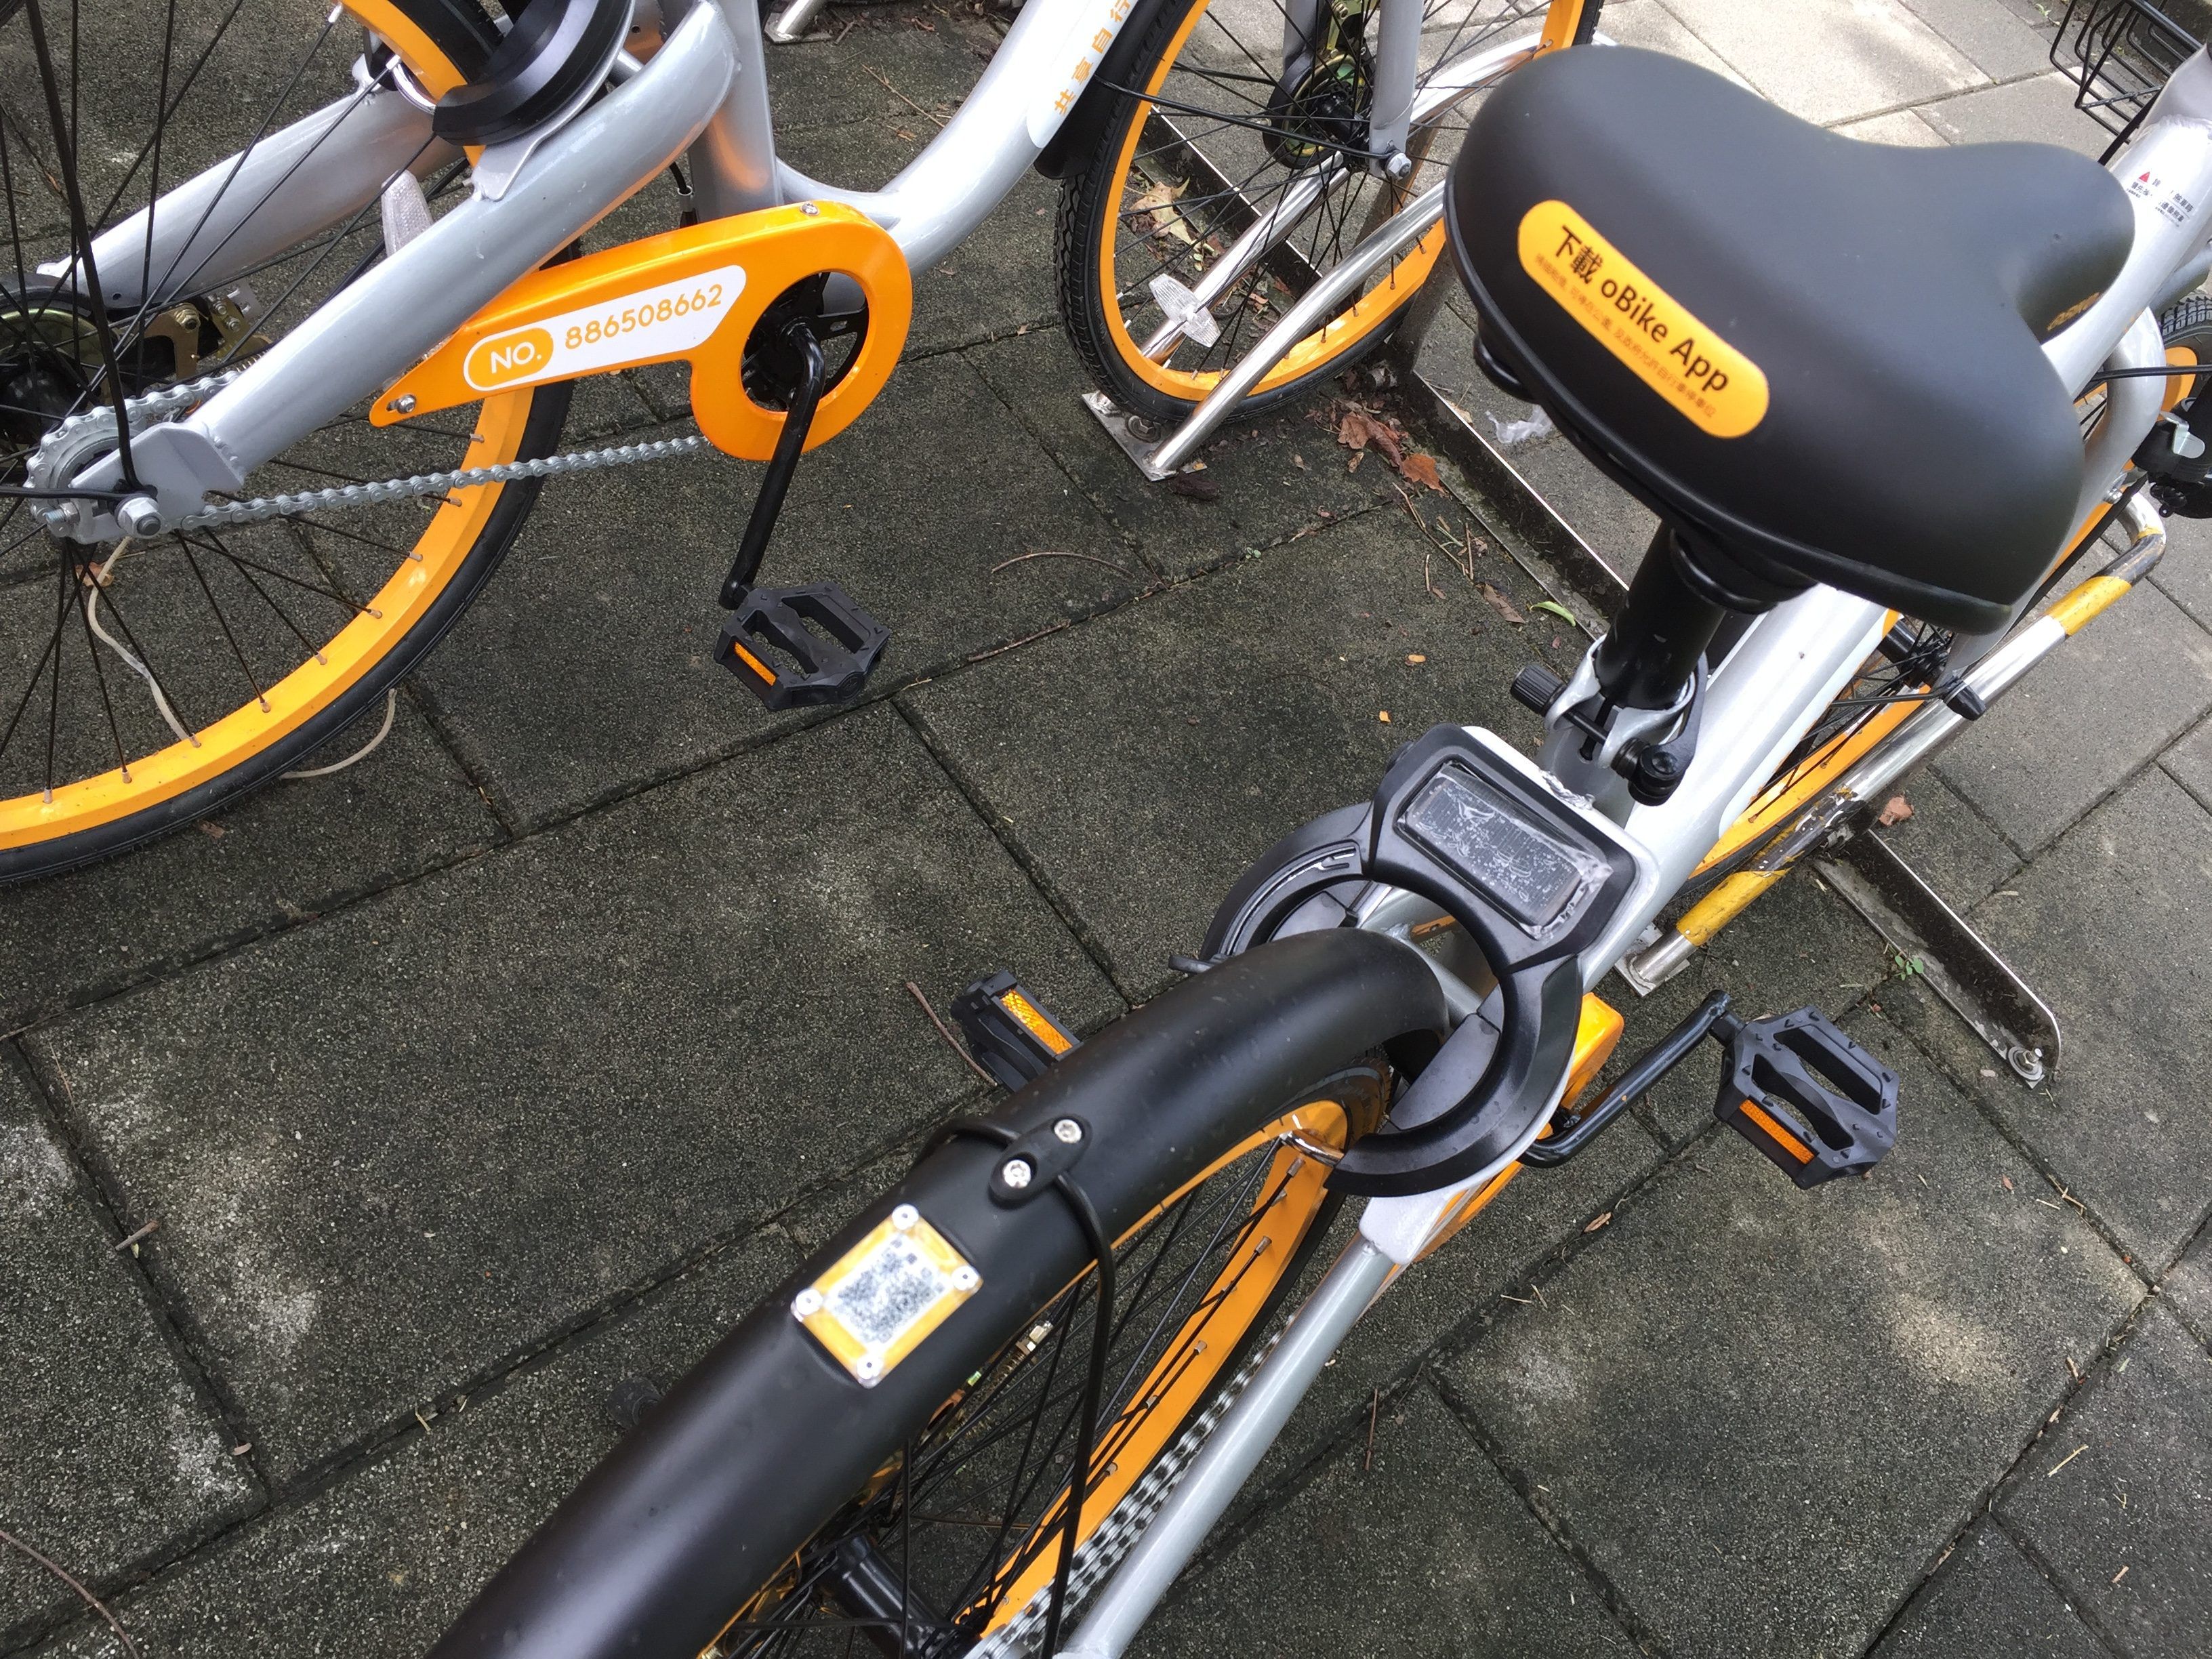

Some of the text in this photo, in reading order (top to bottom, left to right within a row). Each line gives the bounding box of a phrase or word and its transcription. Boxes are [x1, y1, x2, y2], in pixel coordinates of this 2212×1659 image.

[489, 283, 723, 374] NO. 886508662
[1555, 224, 1604, 285] 下載
[1601, 278, 1669, 344] oBike
[1670, 337, 1729, 392] App
